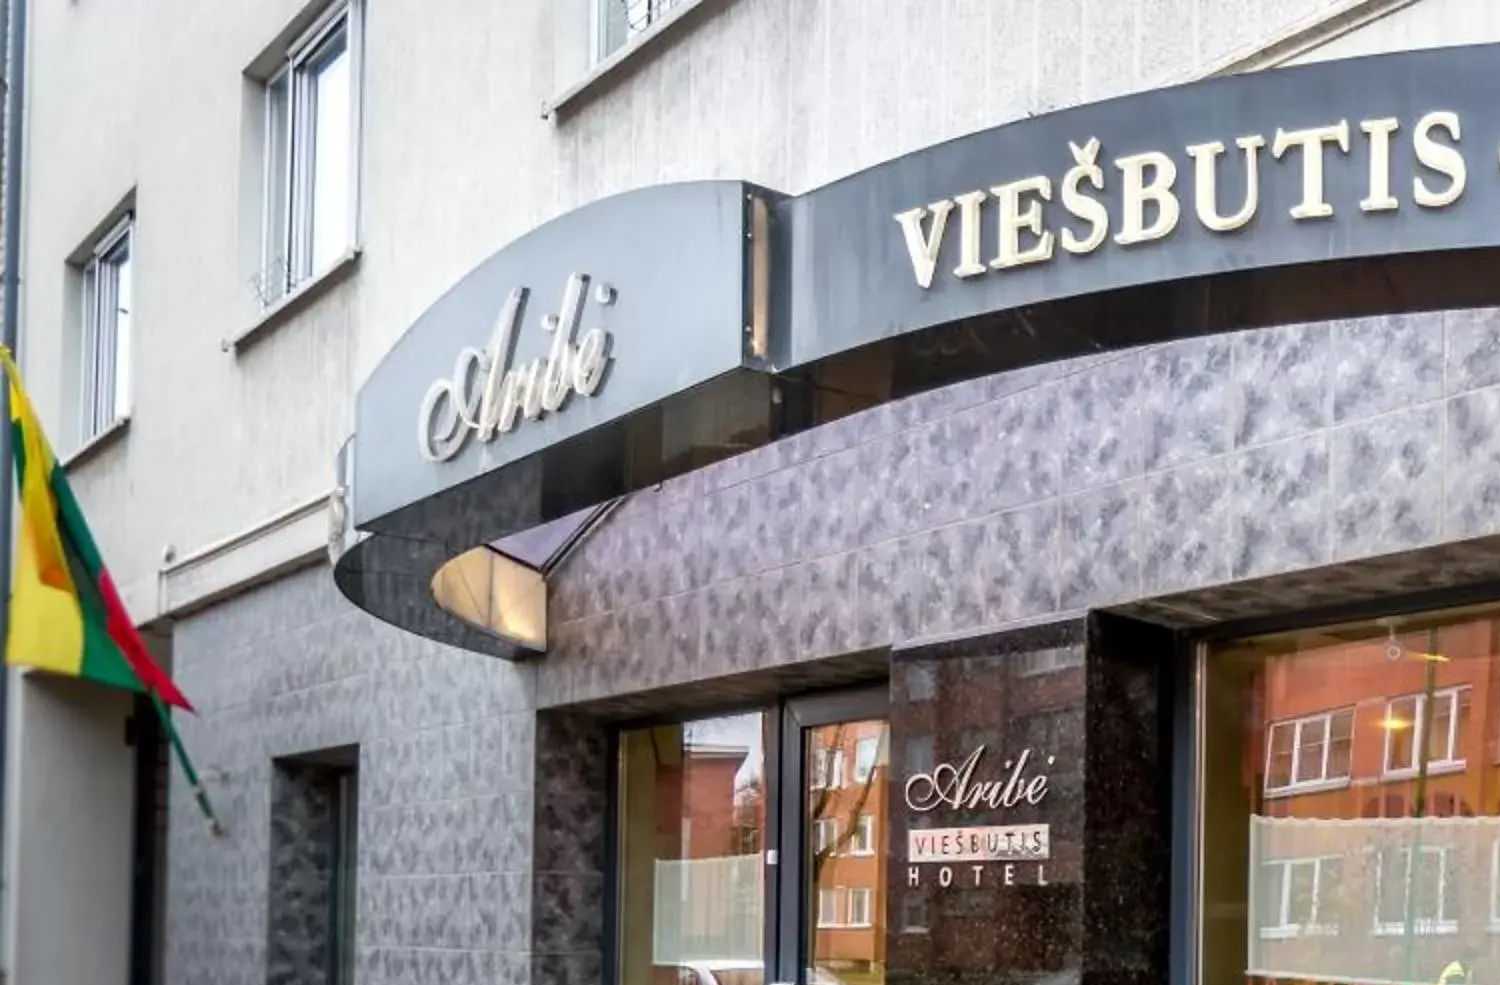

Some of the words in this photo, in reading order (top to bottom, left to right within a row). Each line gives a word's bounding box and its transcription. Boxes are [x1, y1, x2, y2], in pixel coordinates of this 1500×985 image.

[894, 110, 1467, 290] VIEŠBUTIS
[914, 830, 1042, 857] VIEŠBUTIS
[908, 864, 1049, 887] HOTEL
